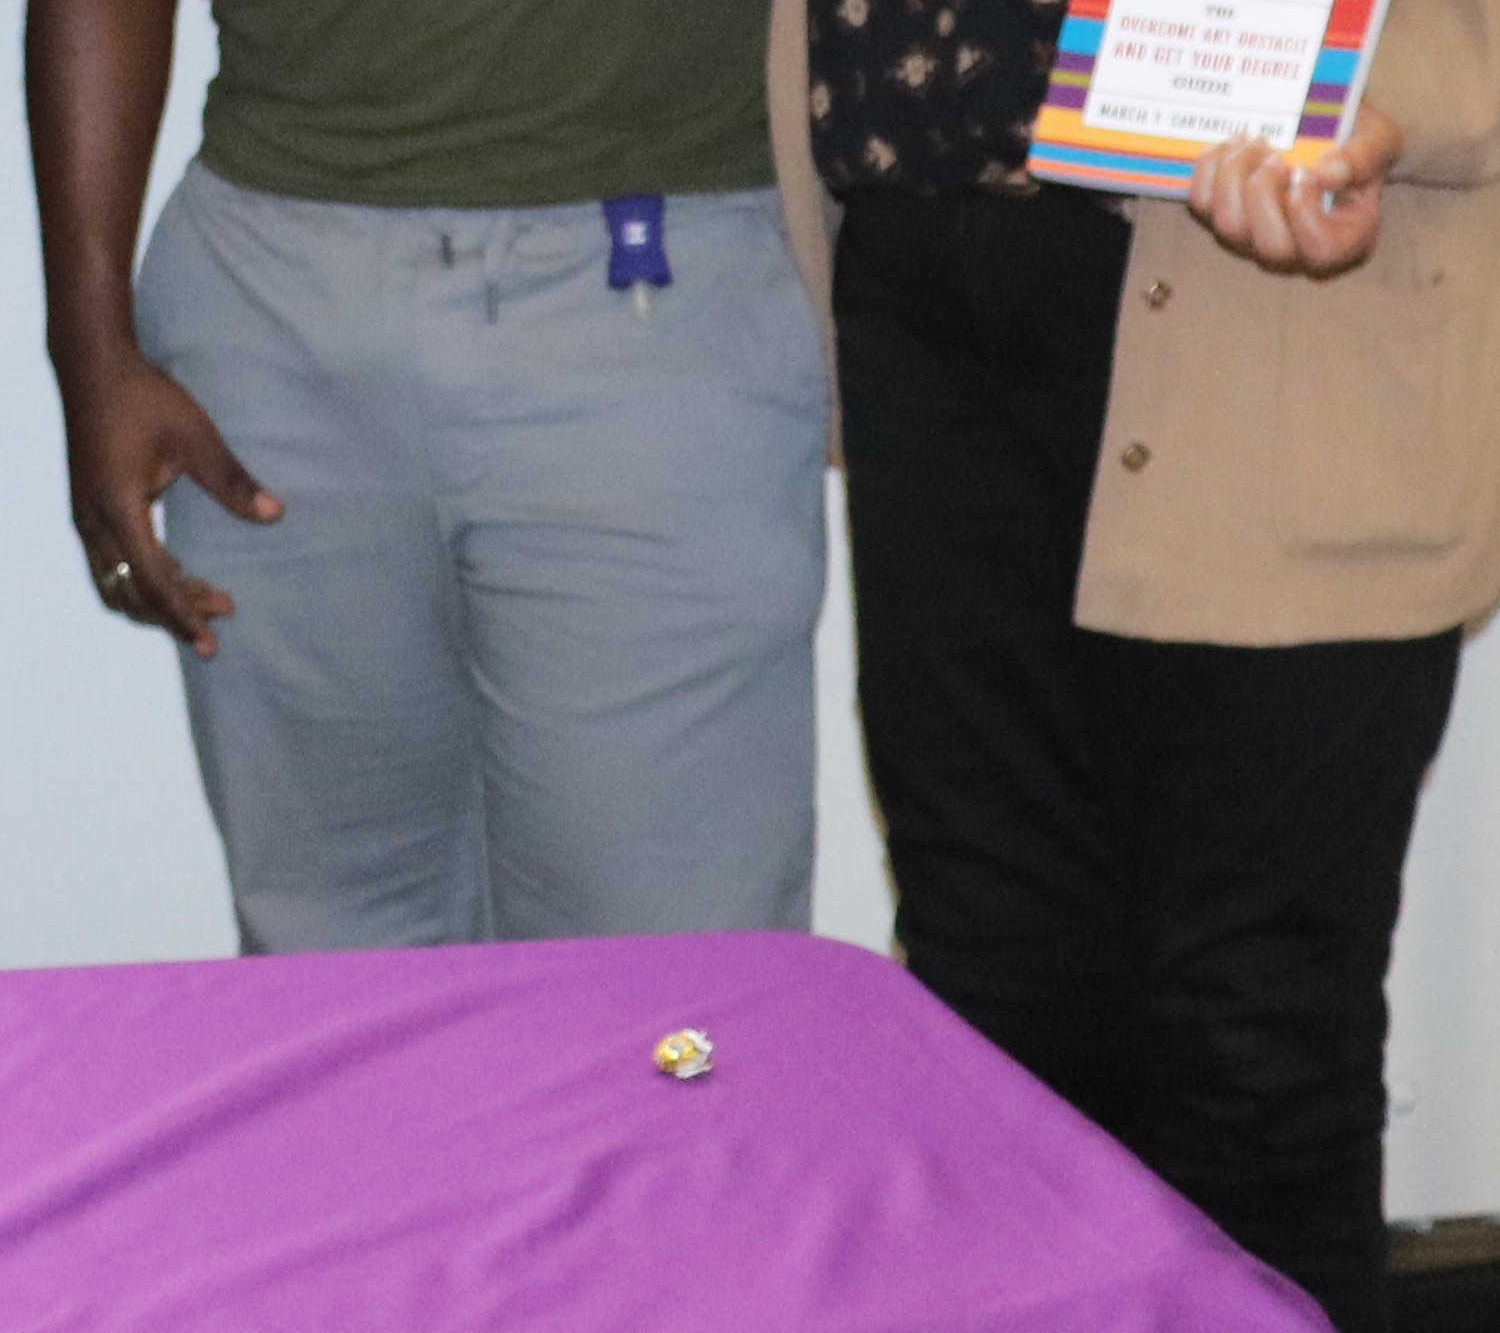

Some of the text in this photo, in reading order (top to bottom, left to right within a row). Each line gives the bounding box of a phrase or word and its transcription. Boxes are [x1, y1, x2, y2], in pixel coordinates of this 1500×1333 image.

[1120, 15, 1310, 55] OVERCOME ANY OBSTACLE
[1114, 40, 1302, 80] AND GET YOUR DEGREE
[1171, 76, 1233, 96] GUIDE
[1100, 102, 1149, 123] MARCIA
